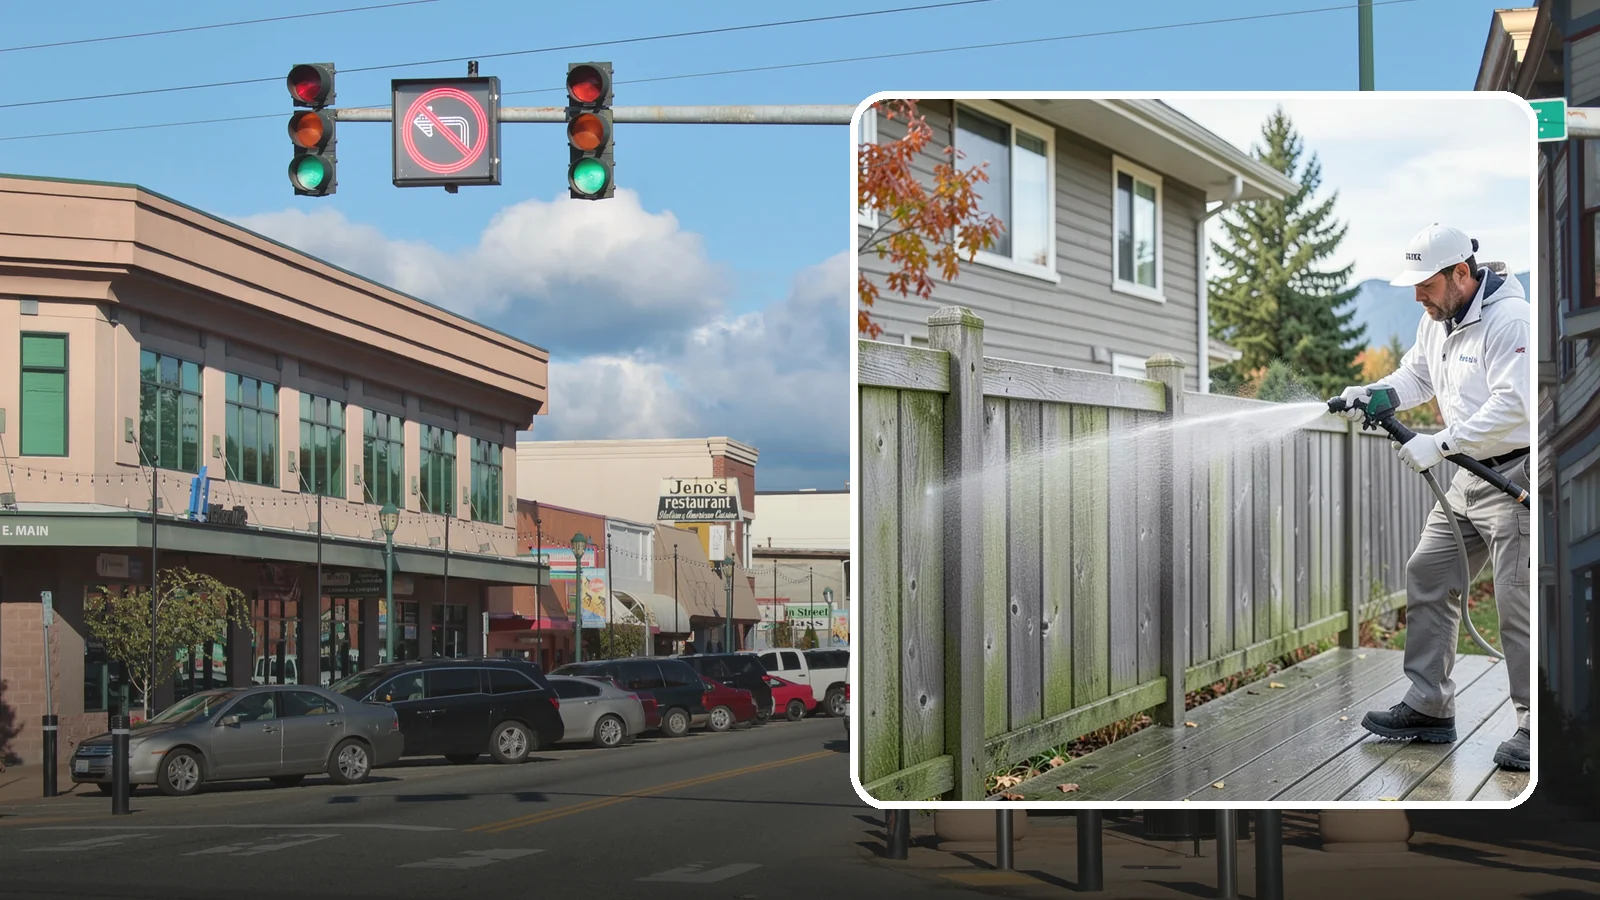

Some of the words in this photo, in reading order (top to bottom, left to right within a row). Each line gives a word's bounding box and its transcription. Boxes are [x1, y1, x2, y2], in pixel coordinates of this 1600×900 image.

[669, 480, 727, 494] Jeno's
[665, 496, 731, 509] restaurant
[686, 509, 714, 519] American
[715, 509, 738, 519] Cuisine
[2, 525, 13, 536] E.
[15, 525, 49, 536] MAIN
[797, 607, 829, 617] Street
[790, 619, 823, 627] lass
